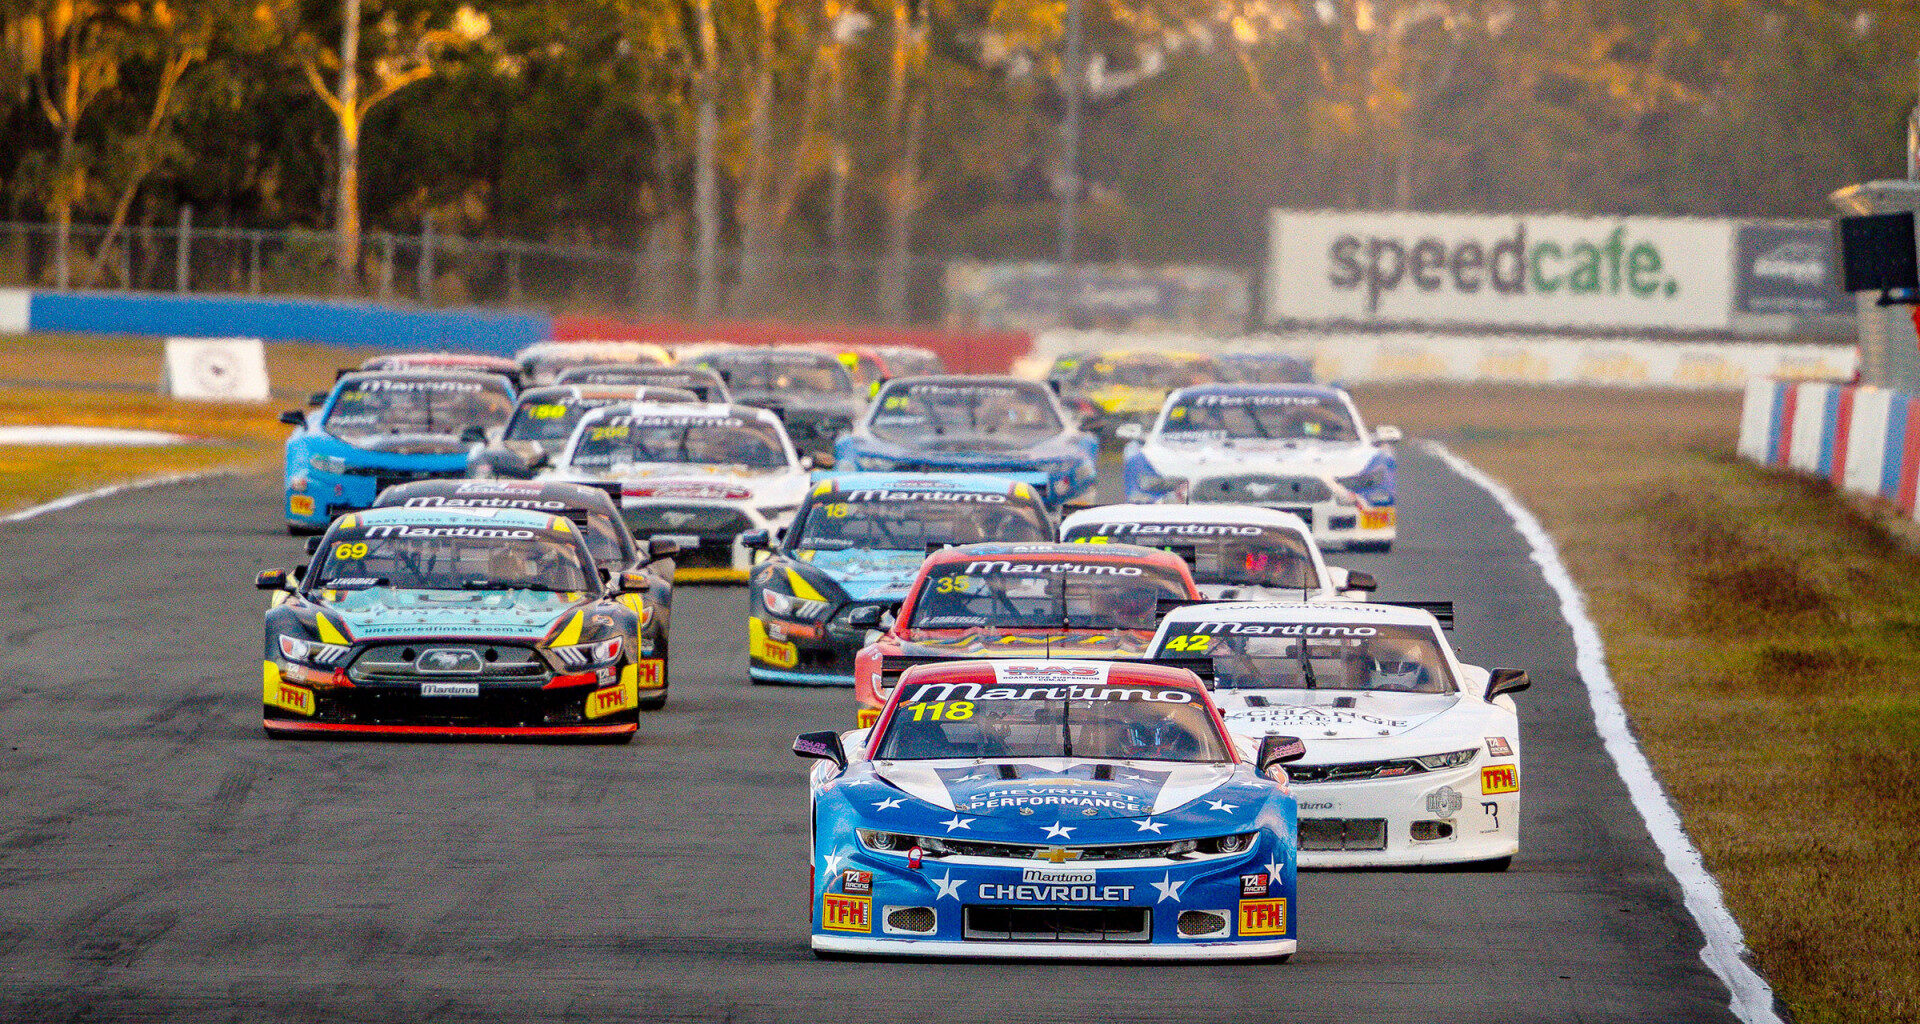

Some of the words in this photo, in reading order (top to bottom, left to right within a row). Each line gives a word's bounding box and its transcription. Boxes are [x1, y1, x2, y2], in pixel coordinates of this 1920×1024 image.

[824, 503, 848, 518] 18
[335, 542, 369, 561] 69
[936, 575, 970, 594] 35
[1165, 635, 1211, 652] 42
[279, 685, 304, 709] TFH
[596, 688, 624, 709] TFH
[908, 682, 1193, 705] Maritimo
[908, 701, 975, 722] 118
[1483, 768, 1512, 789] TFH
[970, 787, 1140, 802] CHEVROLET
[971, 796, 1142, 811] PERFORMANCE
[844, 871, 870, 883] TA2
[979, 883, 1135, 901] CHEVROLET
[826, 898, 864, 925] TFH
[1243, 903, 1280, 929] TFH
